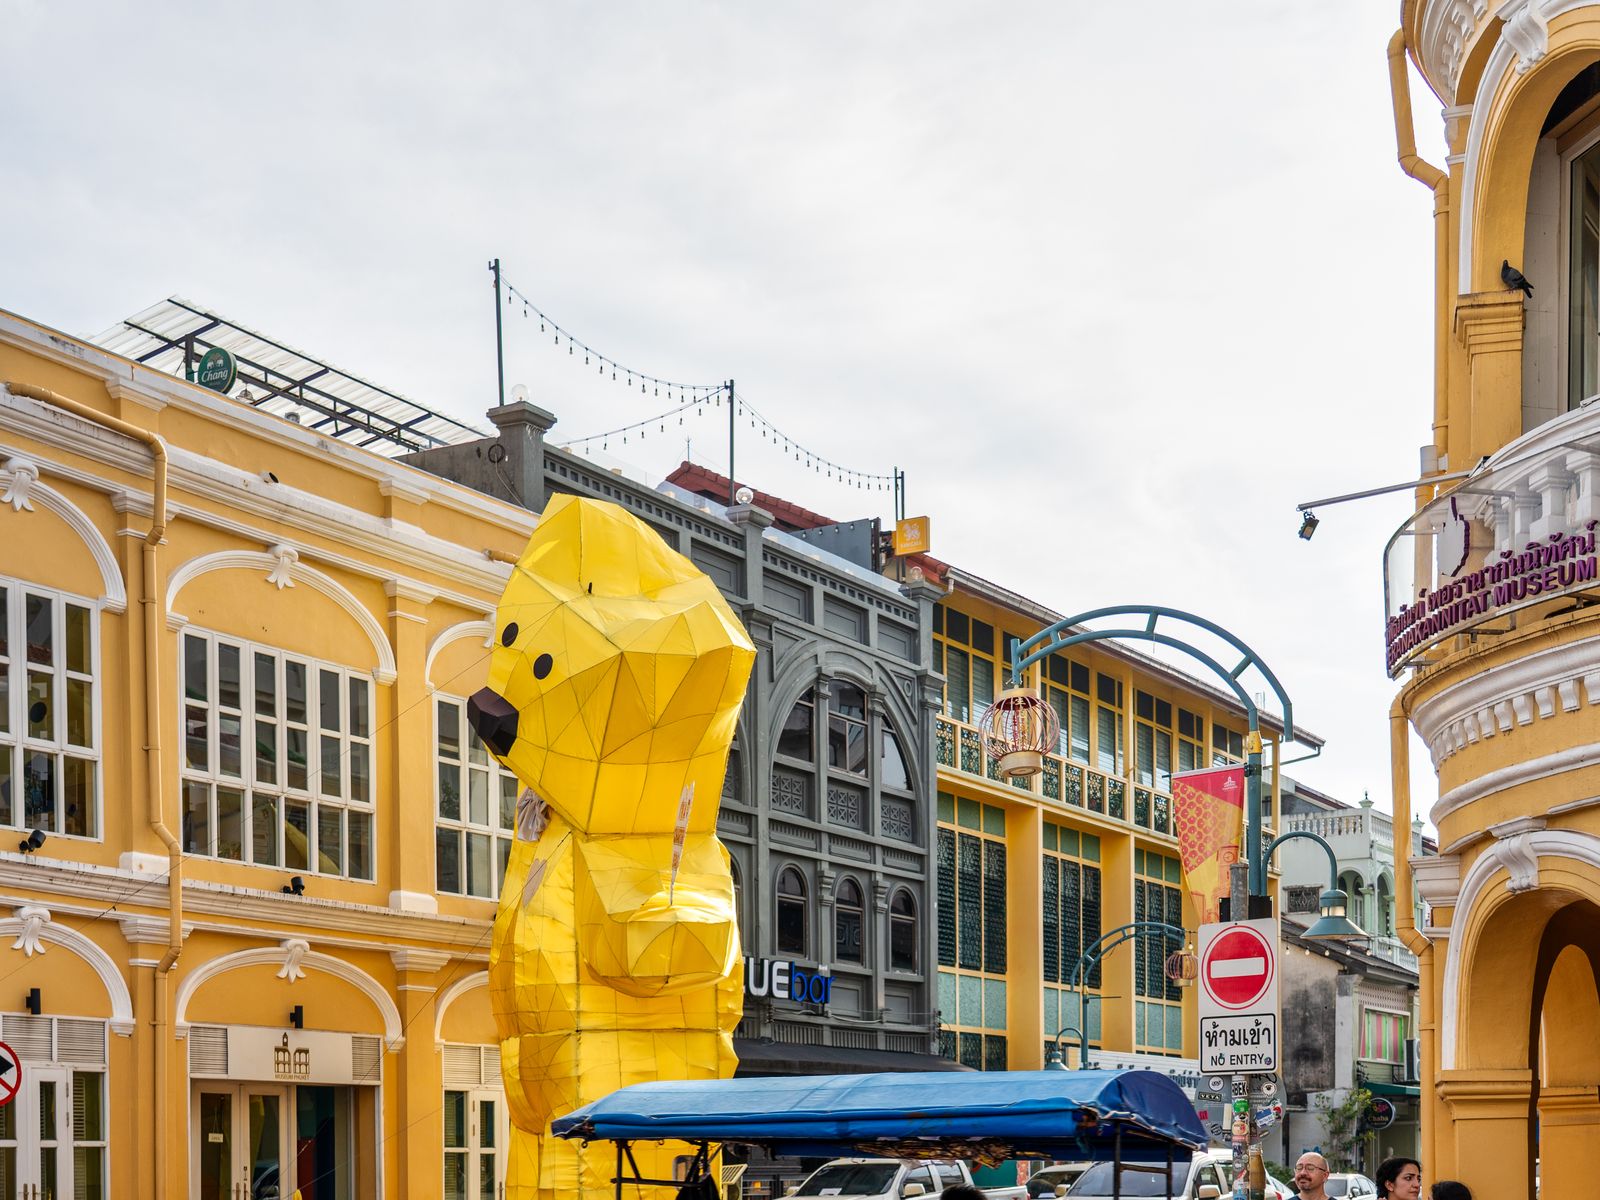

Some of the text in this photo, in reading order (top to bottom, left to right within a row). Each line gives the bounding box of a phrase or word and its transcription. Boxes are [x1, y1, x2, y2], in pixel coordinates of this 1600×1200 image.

[201, 369, 228, 382] Chang
[1387, 556, 1598, 668] ERANAKANNITAT MUSEUM
[1205, 1018, 1271, 1048] ห้ามเข้า
[1210, 1052, 1265, 1066] NO ENTRY
